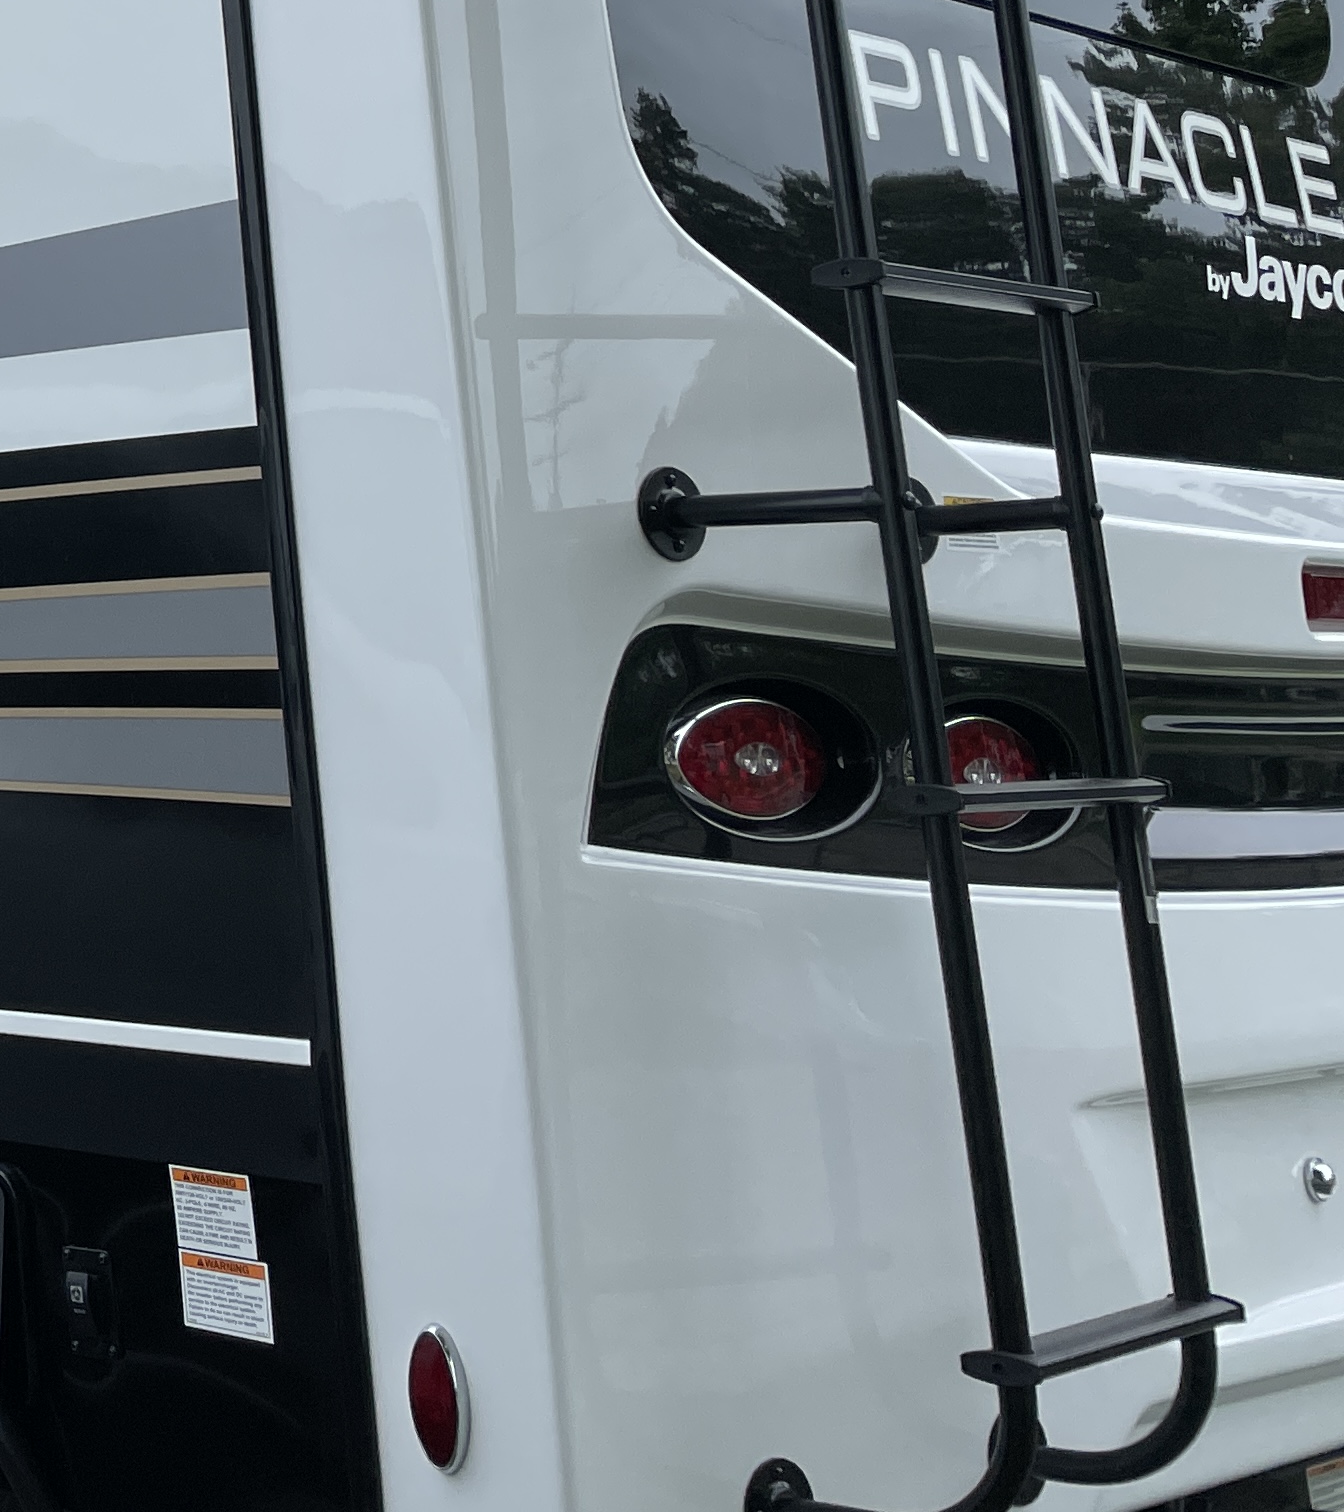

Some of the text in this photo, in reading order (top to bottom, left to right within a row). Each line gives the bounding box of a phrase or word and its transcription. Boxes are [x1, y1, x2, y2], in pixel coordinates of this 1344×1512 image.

[848, 29, 1344, 239] PINNACLE
[1206, 264, 1231, 300] by
[192, 1174, 236, 1187] WARNING
[205, 1259, 249, 1274] WARNING
